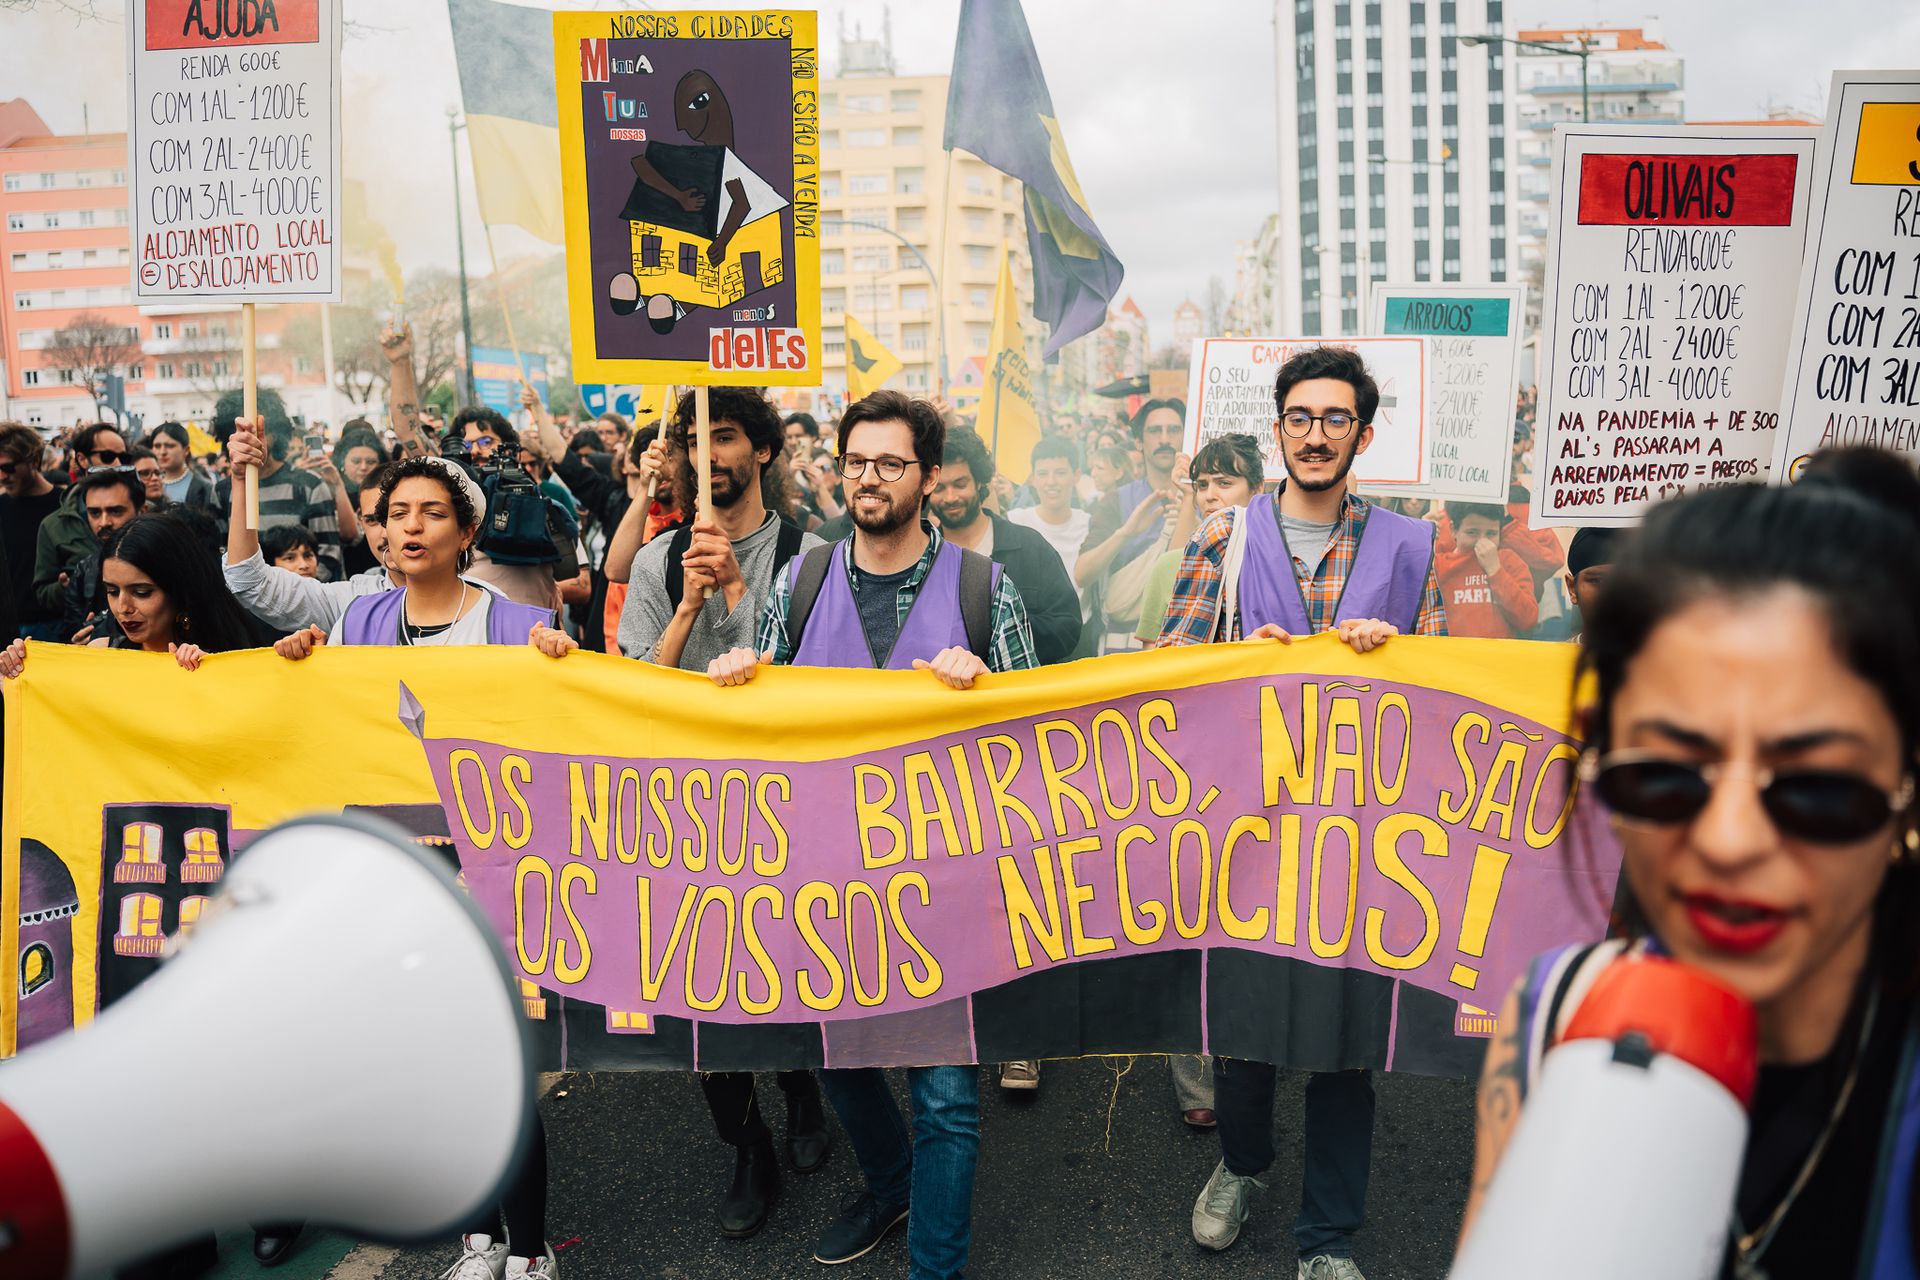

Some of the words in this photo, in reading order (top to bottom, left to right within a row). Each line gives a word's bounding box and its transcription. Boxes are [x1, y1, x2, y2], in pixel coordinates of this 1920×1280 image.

[183, 0, 279, 41] AJUDA
[610, 14, 679, 39] NOSSAS
[691, 14, 793, 38] CIDADES
[181, 54, 231, 80] RENDA
[239, 50, 281, 72] 600€
[791, 48, 818, 80] NÃO
[151, 91, 192, 125] COM
[602, 91, 648, 120] TUA
[793, 89, 819, 146] ESTÃO
[611, 128, 646, 141] nossas
[150, 138, 192, 174] COM
[152, 185, 193, 225] COM
[794, 173, 818, 239] VENDA
[1624, 160, 1736, 219] OLIVAIS
[143, 223, 259, 260] ALOJAMENTO
[276, 219, 332, 249] LOCAL
[166, 251, 319, 290] DESALOJAMENTO
[1834, 248, 1896, 297] COM
[1403, 301, 1474, 333] ARROIOS
[1572, 283, 1609, 323] COM
[1675, 282, 1746, 320] 1200€
[1827, 302, 1885, 348] COM
[1570, 327, 1608, 363] COM
[1672, 325, 1740, 360] 2400€
[1209, 366, 1221, 384] O
[1226, 367, 1250, 384] SEU
[1568, 365, 1605, 399] COM
[1668, 366, 1733, 400] 4000€
[1816, 354, 1870, 404] COM
[1205, 401, 1219, 416] FOI
[1217, 417, 1246, 430] FUNDO
[1253, 417, 1273, 432] IMOB
[1558, 411, 1584, 432] NA
[1728, 410, 1747, 431] DE
[1751, 411, 1779, 432] 300
[1431, 441, 1459, 460] LOCAL
[1613, 436, 1700, 458] PASSARAM
[1707, 438, 1723, 457] A
[1459, 465, 1489, 483] LOCAL
[1550, 463, 1689, 486] ARRENDAMENTO
[1711, 458, 1758, 480] PREÇOS
[1614, 486, 1649, 505] PELA
[1453, 589, 1492, 605] PART
[1465, 576, 1481, 586] LIFE
[449, 748, 533, 850] OS
[568, 762, 791, 877] NOSSOS
[1260, 682, 1411, 808] NÃO
[1438, 712, 1582, 849] SÃO
[513, 855, 597, 984] OS
[637, 871, 944, 1015] VOSSOS
